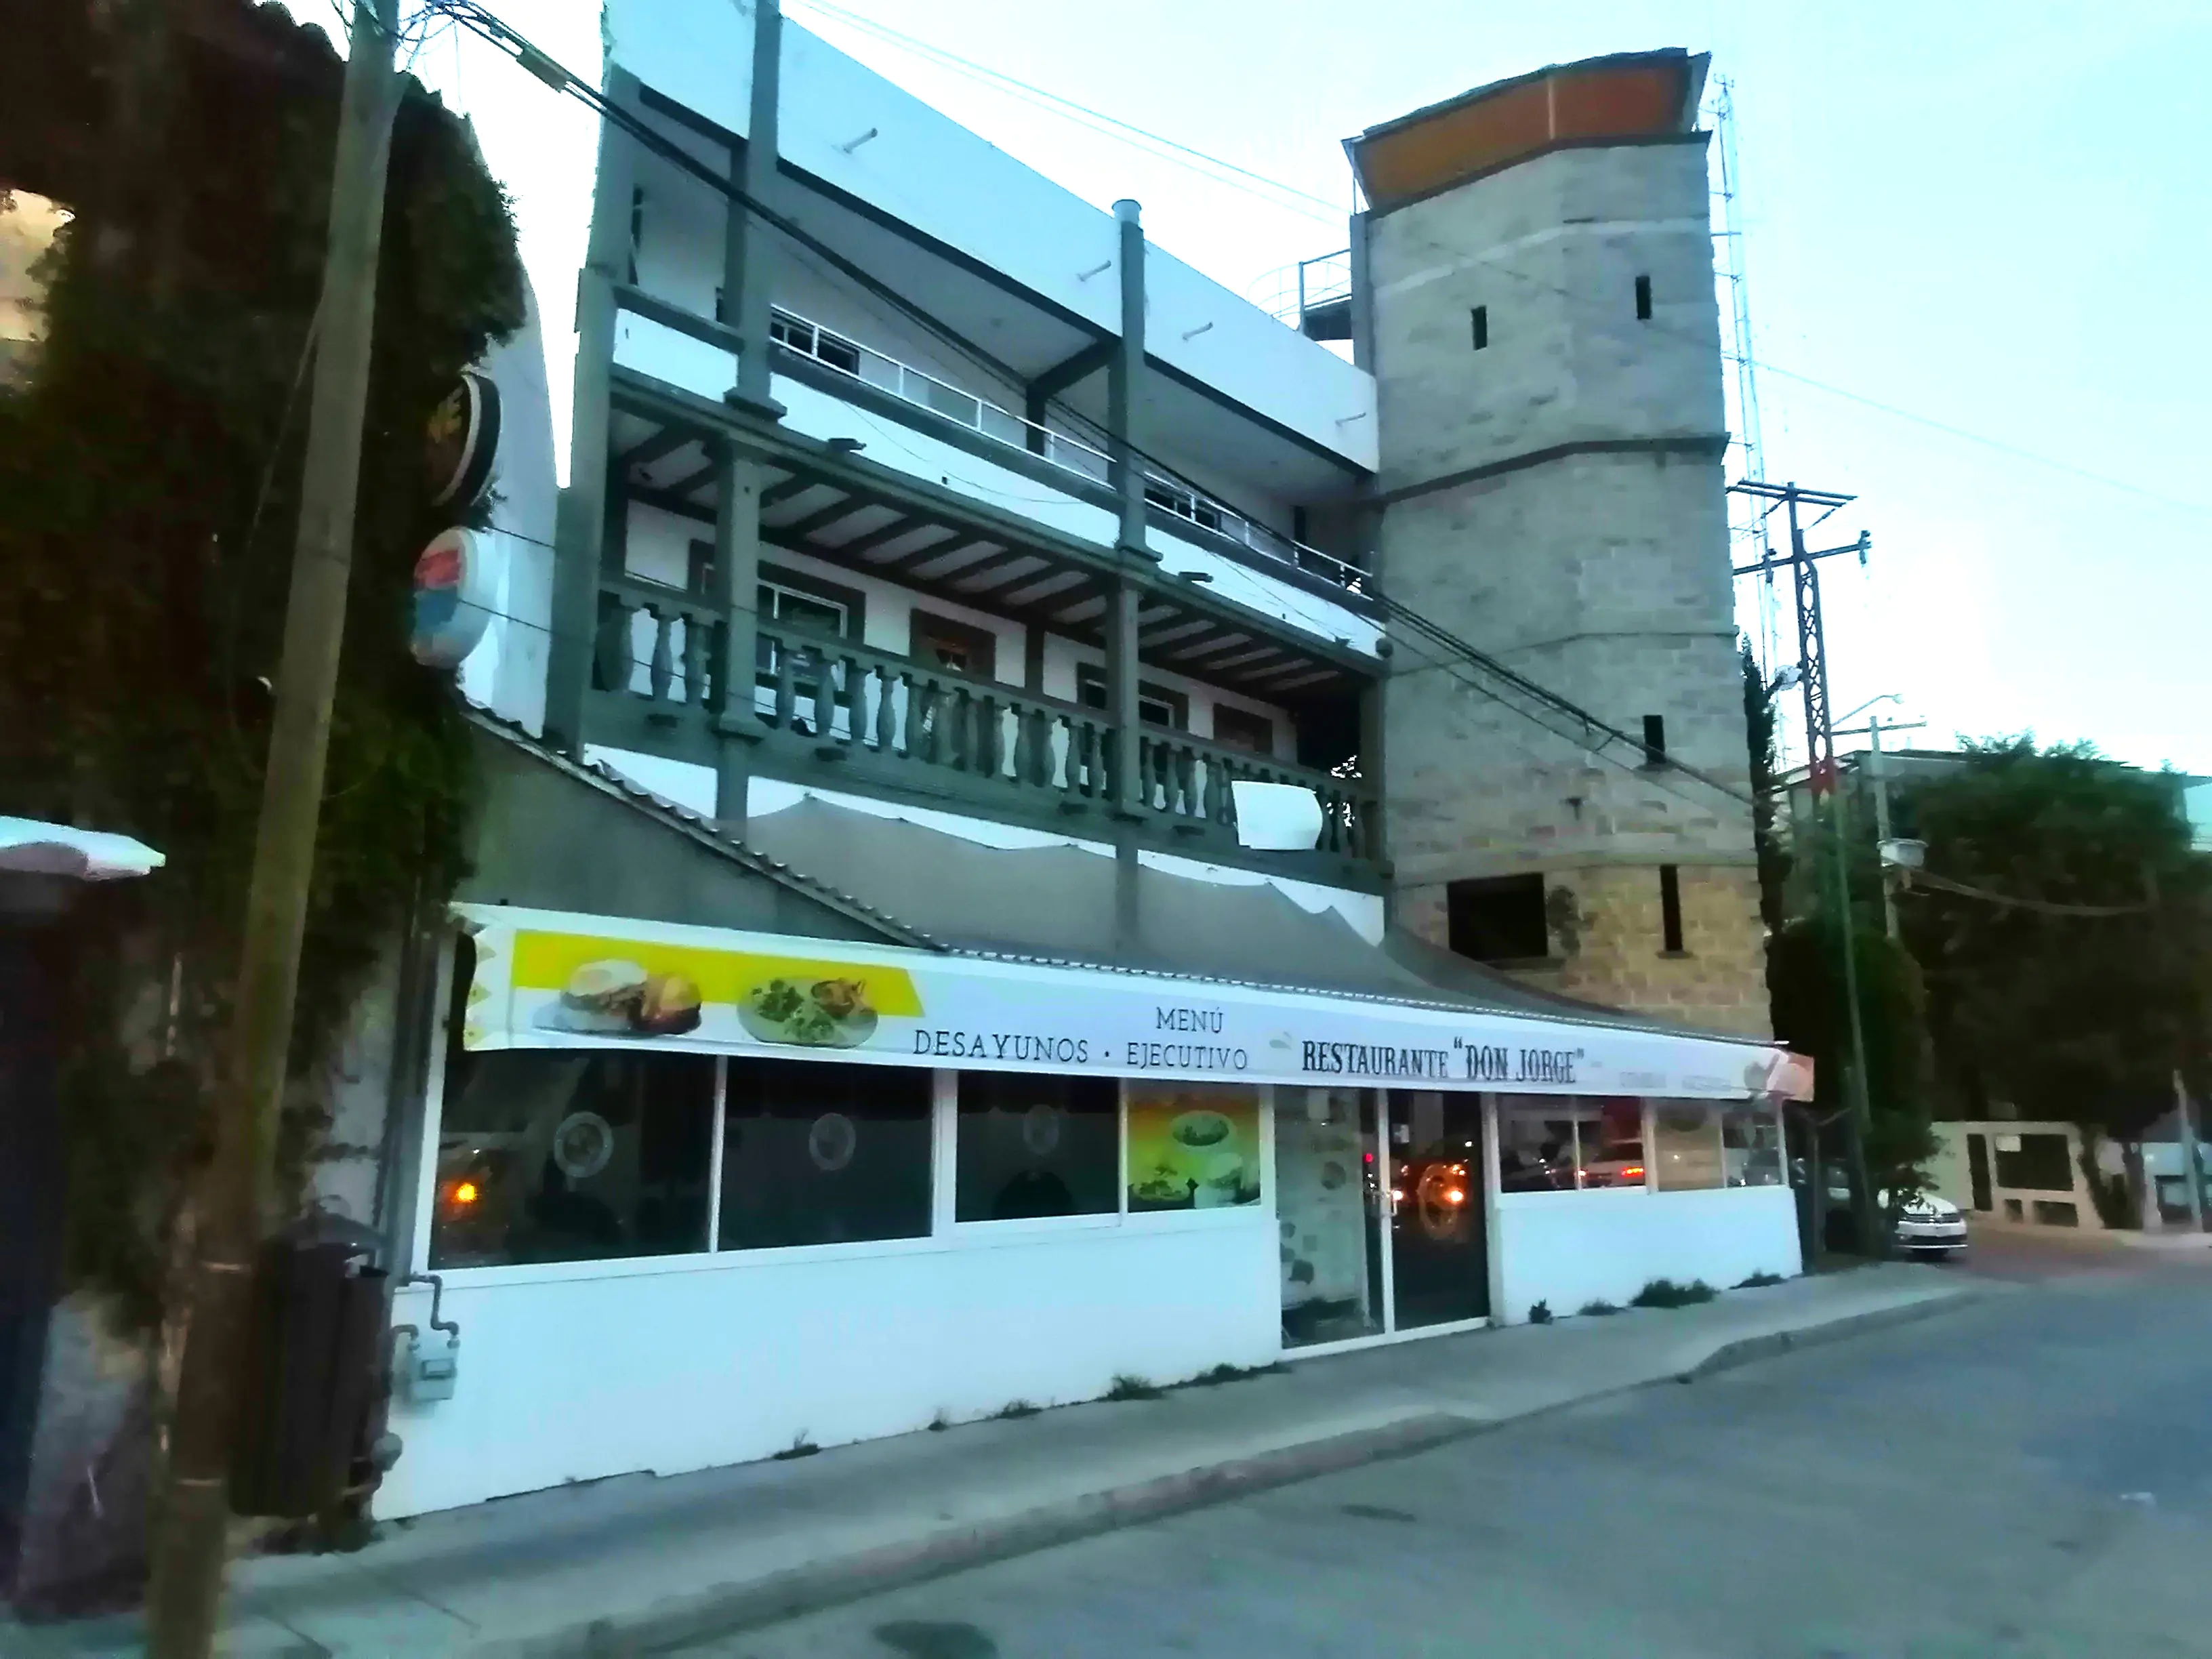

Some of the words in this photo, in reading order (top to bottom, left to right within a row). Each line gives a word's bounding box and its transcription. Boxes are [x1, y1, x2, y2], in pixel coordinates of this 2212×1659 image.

[1156, 1006, 1224, 1033] MENÚ
[914, 1029, 1089, 1063] DESAYUNOS
[1127, 1042, 1248, 1070] EJECUTIVO
[1301, 1040, 1449, 1079] RESTAURANTE
